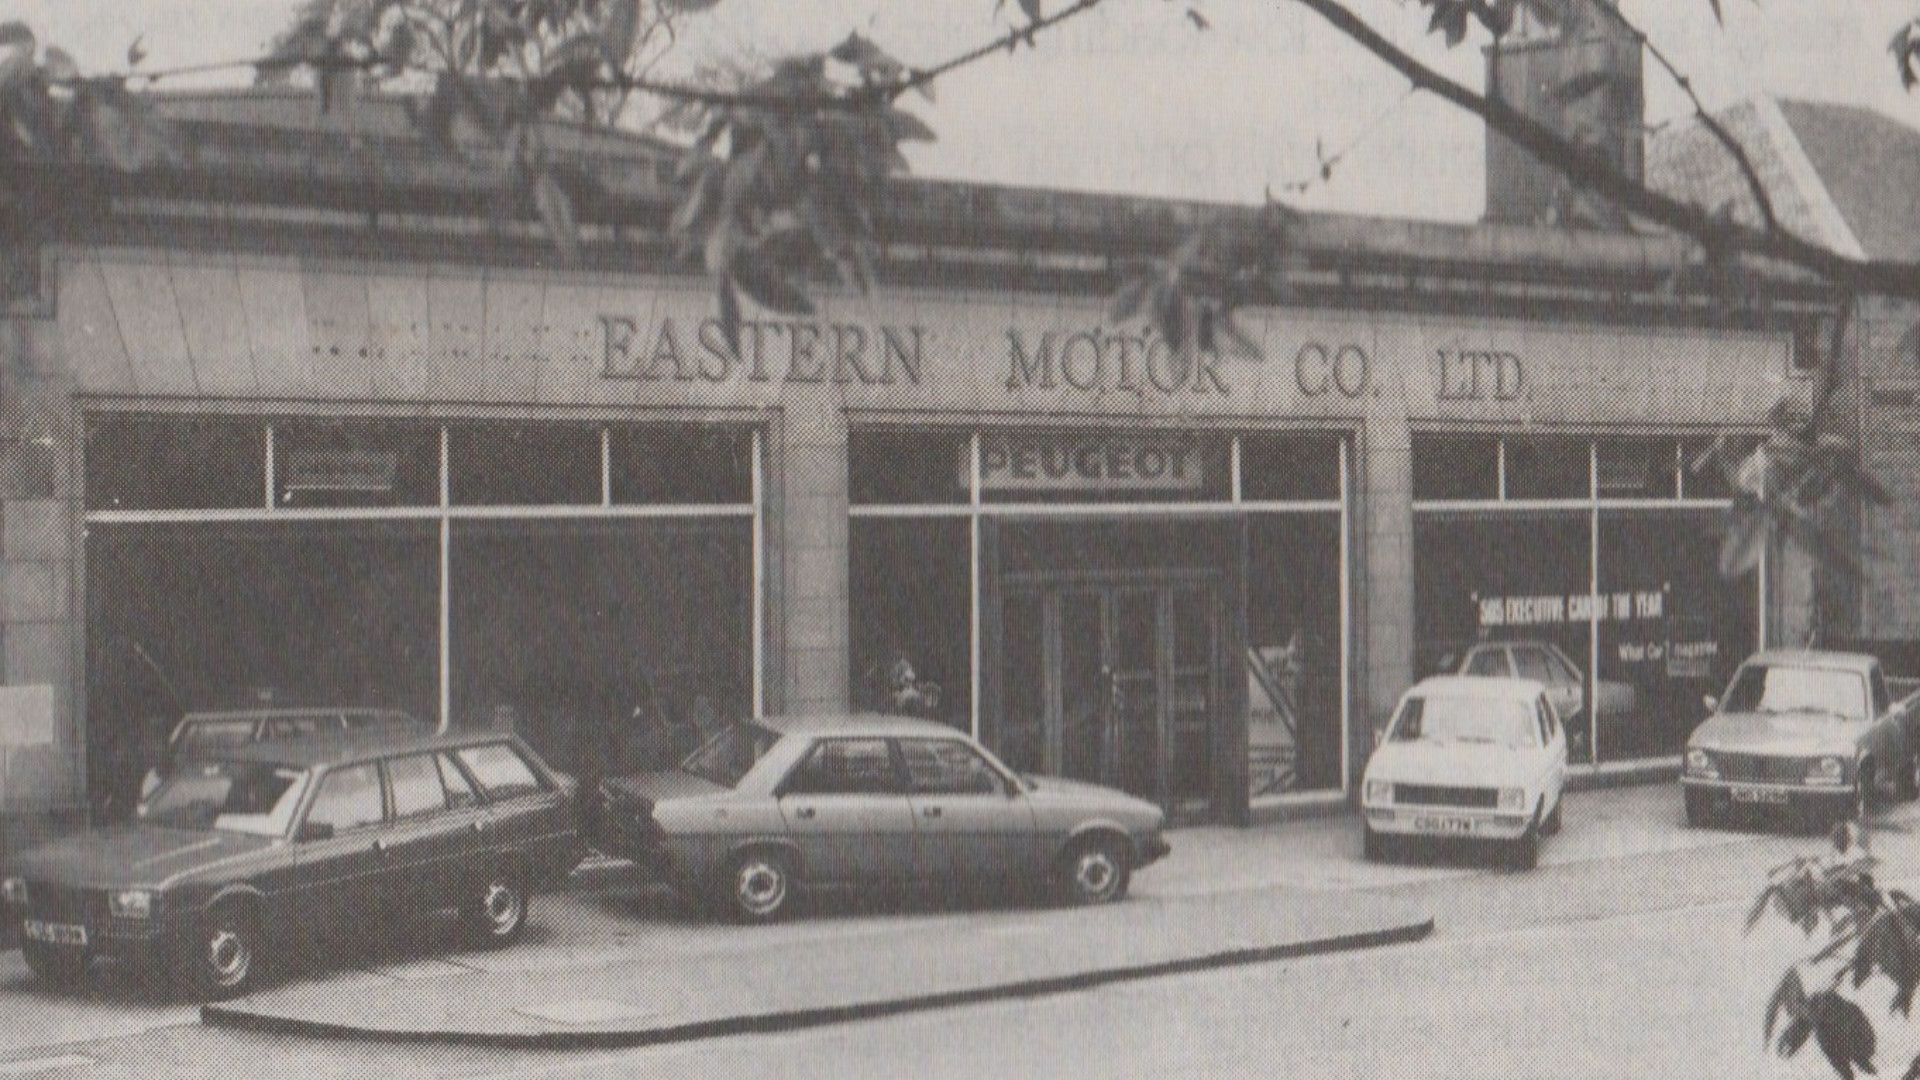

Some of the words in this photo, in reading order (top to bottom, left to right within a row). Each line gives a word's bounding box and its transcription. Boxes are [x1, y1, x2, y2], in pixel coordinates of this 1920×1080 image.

[598, 316, 923, 385] EASTERN
[1004, 326, 1231, 396] MOTOR
[1294, 342, 1379, 398] CO.
[979, 446, 1198, 480] PEUGEOT
